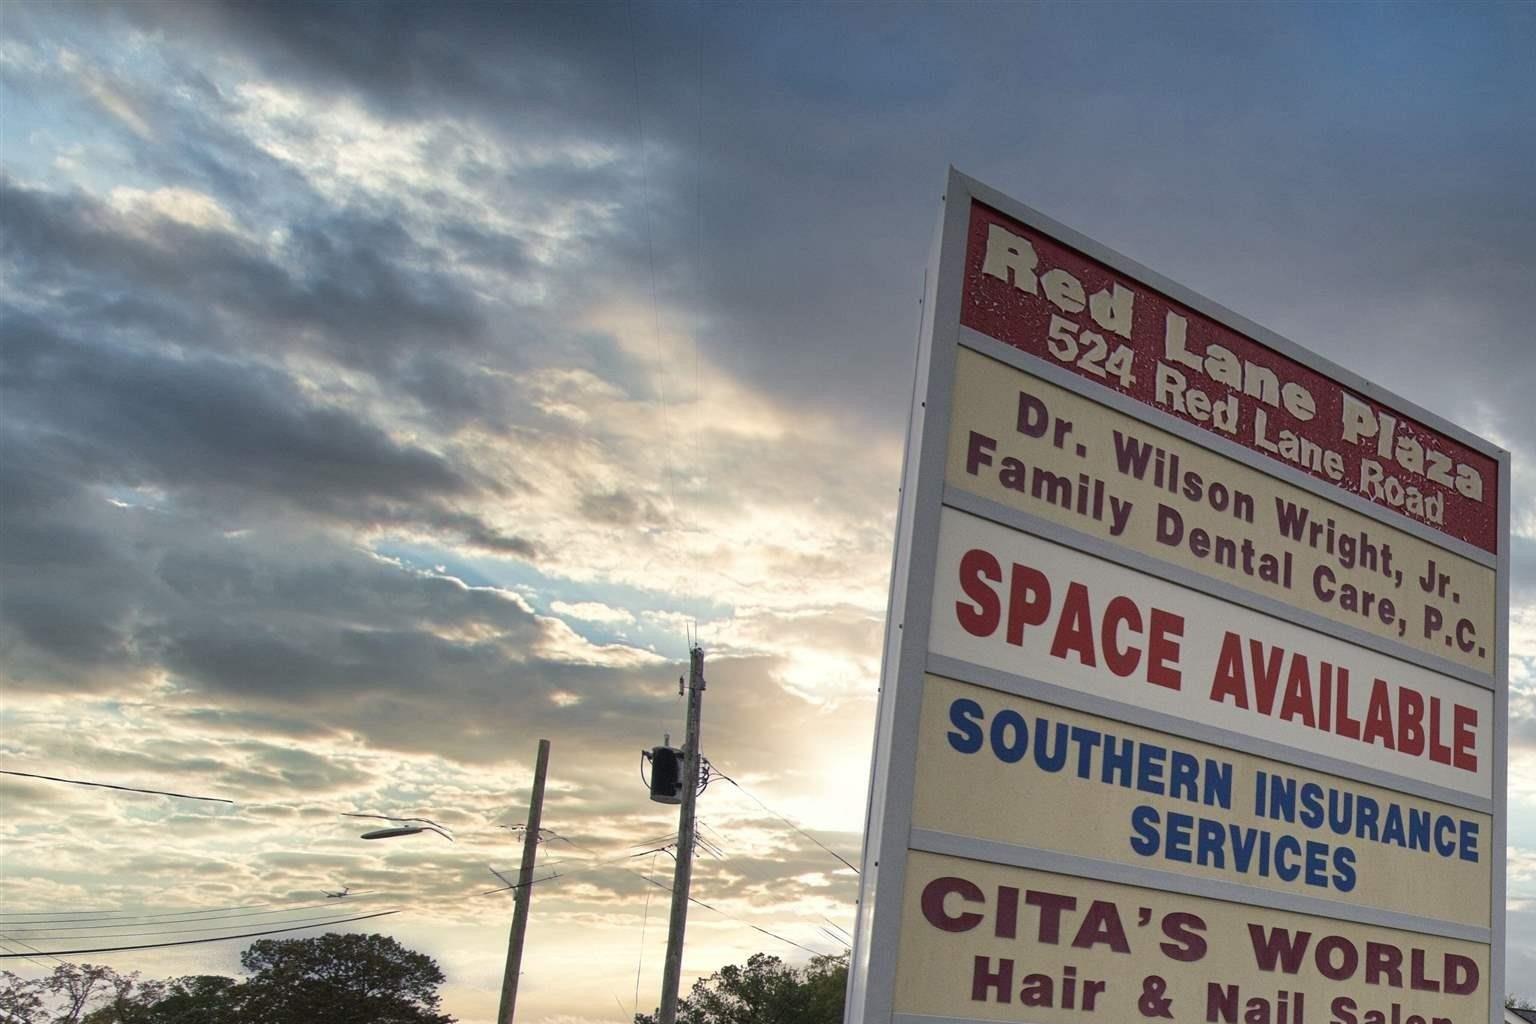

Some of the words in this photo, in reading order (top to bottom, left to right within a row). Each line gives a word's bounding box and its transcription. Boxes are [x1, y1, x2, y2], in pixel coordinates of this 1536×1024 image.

[981, 223, 1135, 340] Red
[1165, 311, 1316, 421] Lane
[1341, 391, 1484, 502] Plaza
[1047, 314, 1136, 391] 524
[1156, 360, 1239, 435] Red
[1254, 407, 1344, 481] Lane
[1360, 458, 1445, 524] Road
[966, 430, 1134, 535] Family
[1156, 503, 1292, 589] Dental
[1313, 565, 1407, 636] Care,
[1424, 606, 1485, 657] P.C.
[1016, 391, 1087, 456] Dr.
[1113, 430, 1255, 523] Wilson
[1275, 497, 1402, 588] Wright,
[1419, 560, 1460, 603] Jr.
[955, 549, 1184, 691] SPACE
[1210, 631, 1478, 772] AVAILABLE
[947, 698, 1232, 810] SOUTHERN
[1255, 771, 1479, 862] INSURANCE
[1130, 805, 1357, 892] SERVICES
[920, 876, 1208, 962] CITA'S
[1247, 923, 1479, 996] WORLD
[972, 956, 1106, 1011] Hair
[1138, 974, 1174, 1019] &
